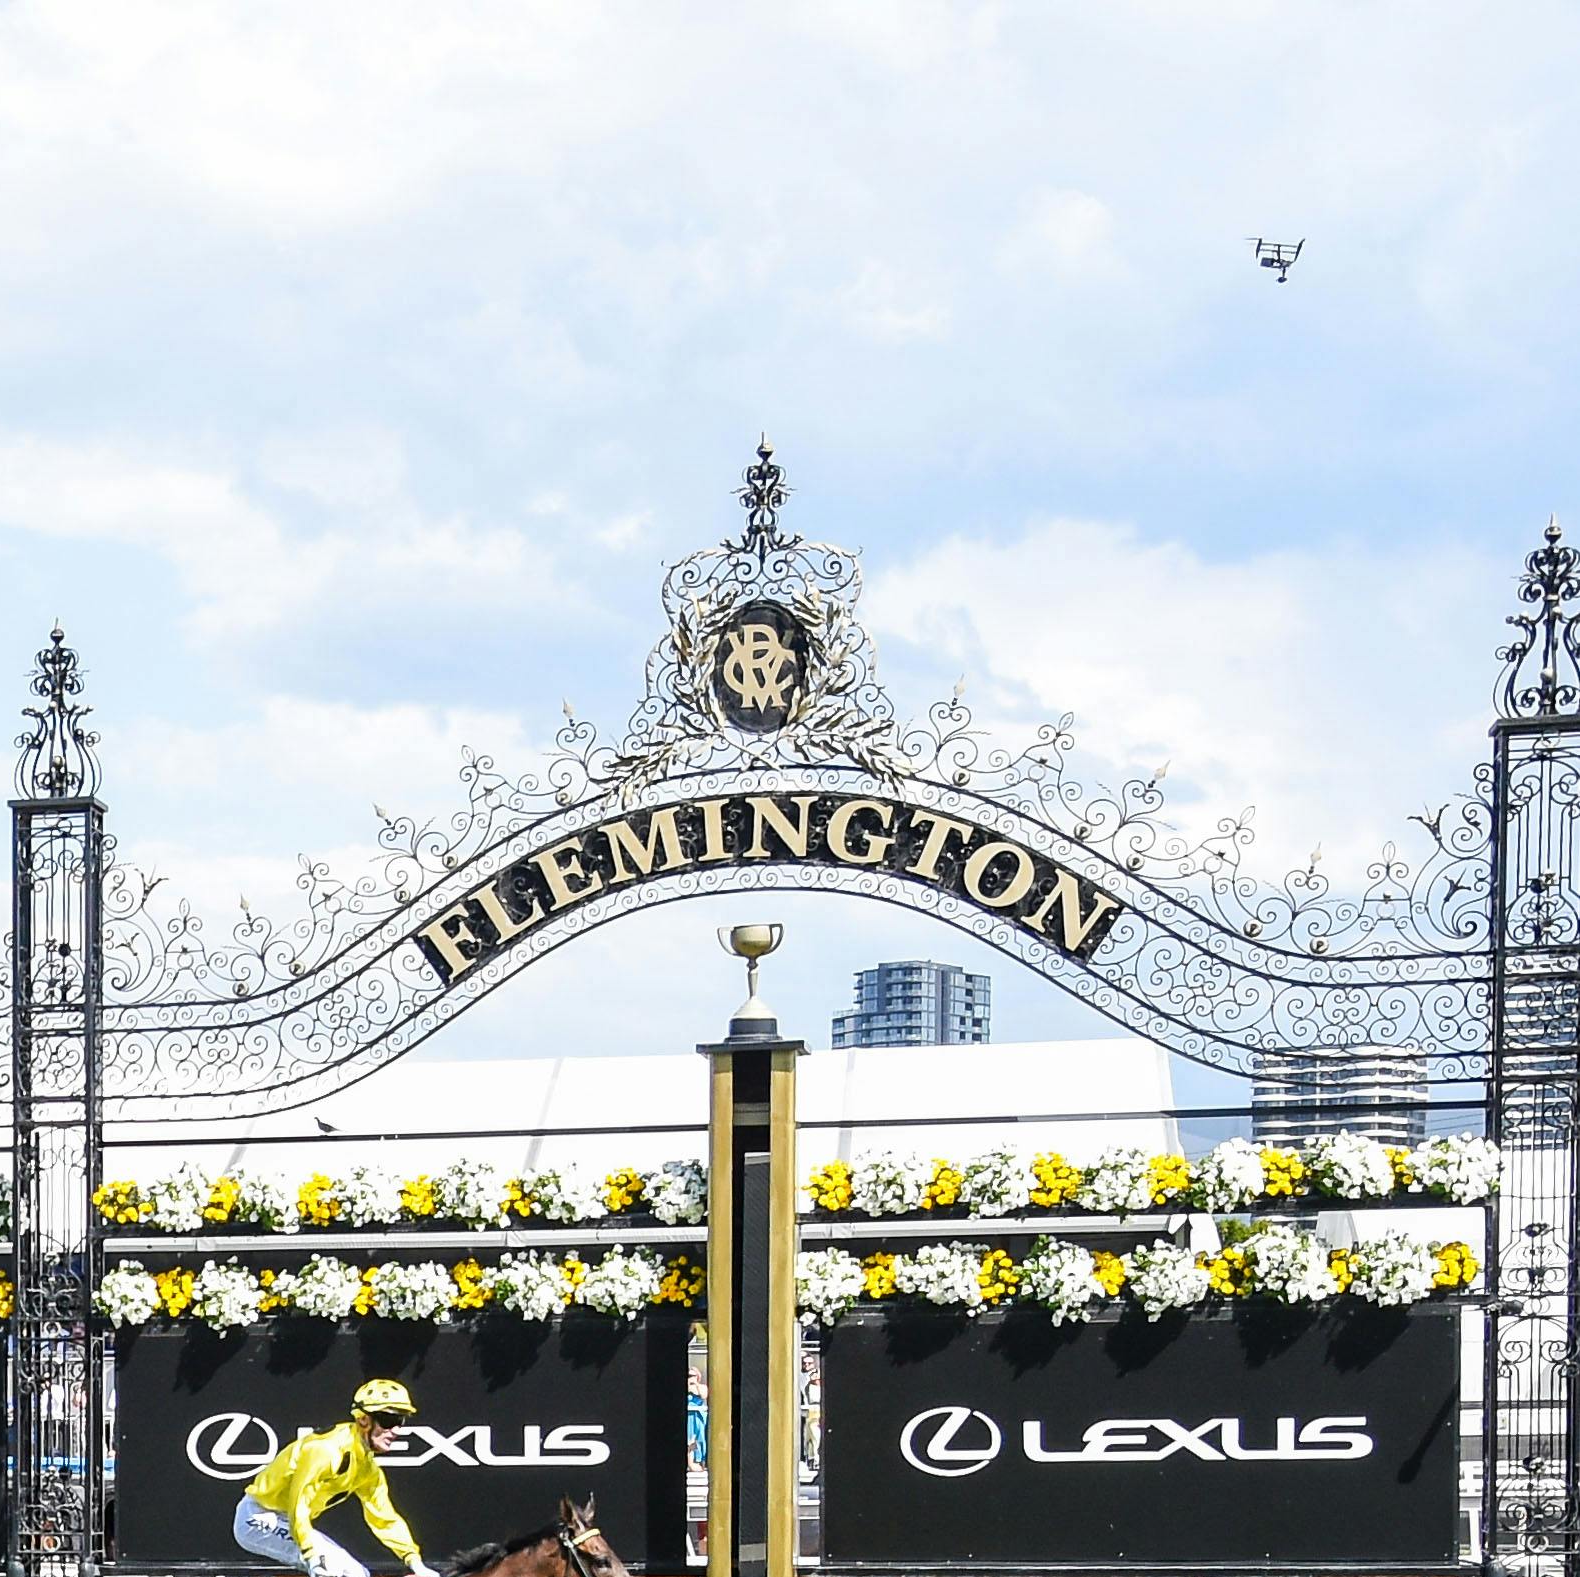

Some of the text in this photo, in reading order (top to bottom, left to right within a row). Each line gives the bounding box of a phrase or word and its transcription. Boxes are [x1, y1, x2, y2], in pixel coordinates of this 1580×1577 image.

[422, 794, 1120, 981] FLEMINGTON
[298, 1425, 611, 1467] EXUS
[1023, 1416, 1375, 1463] LEXUS
